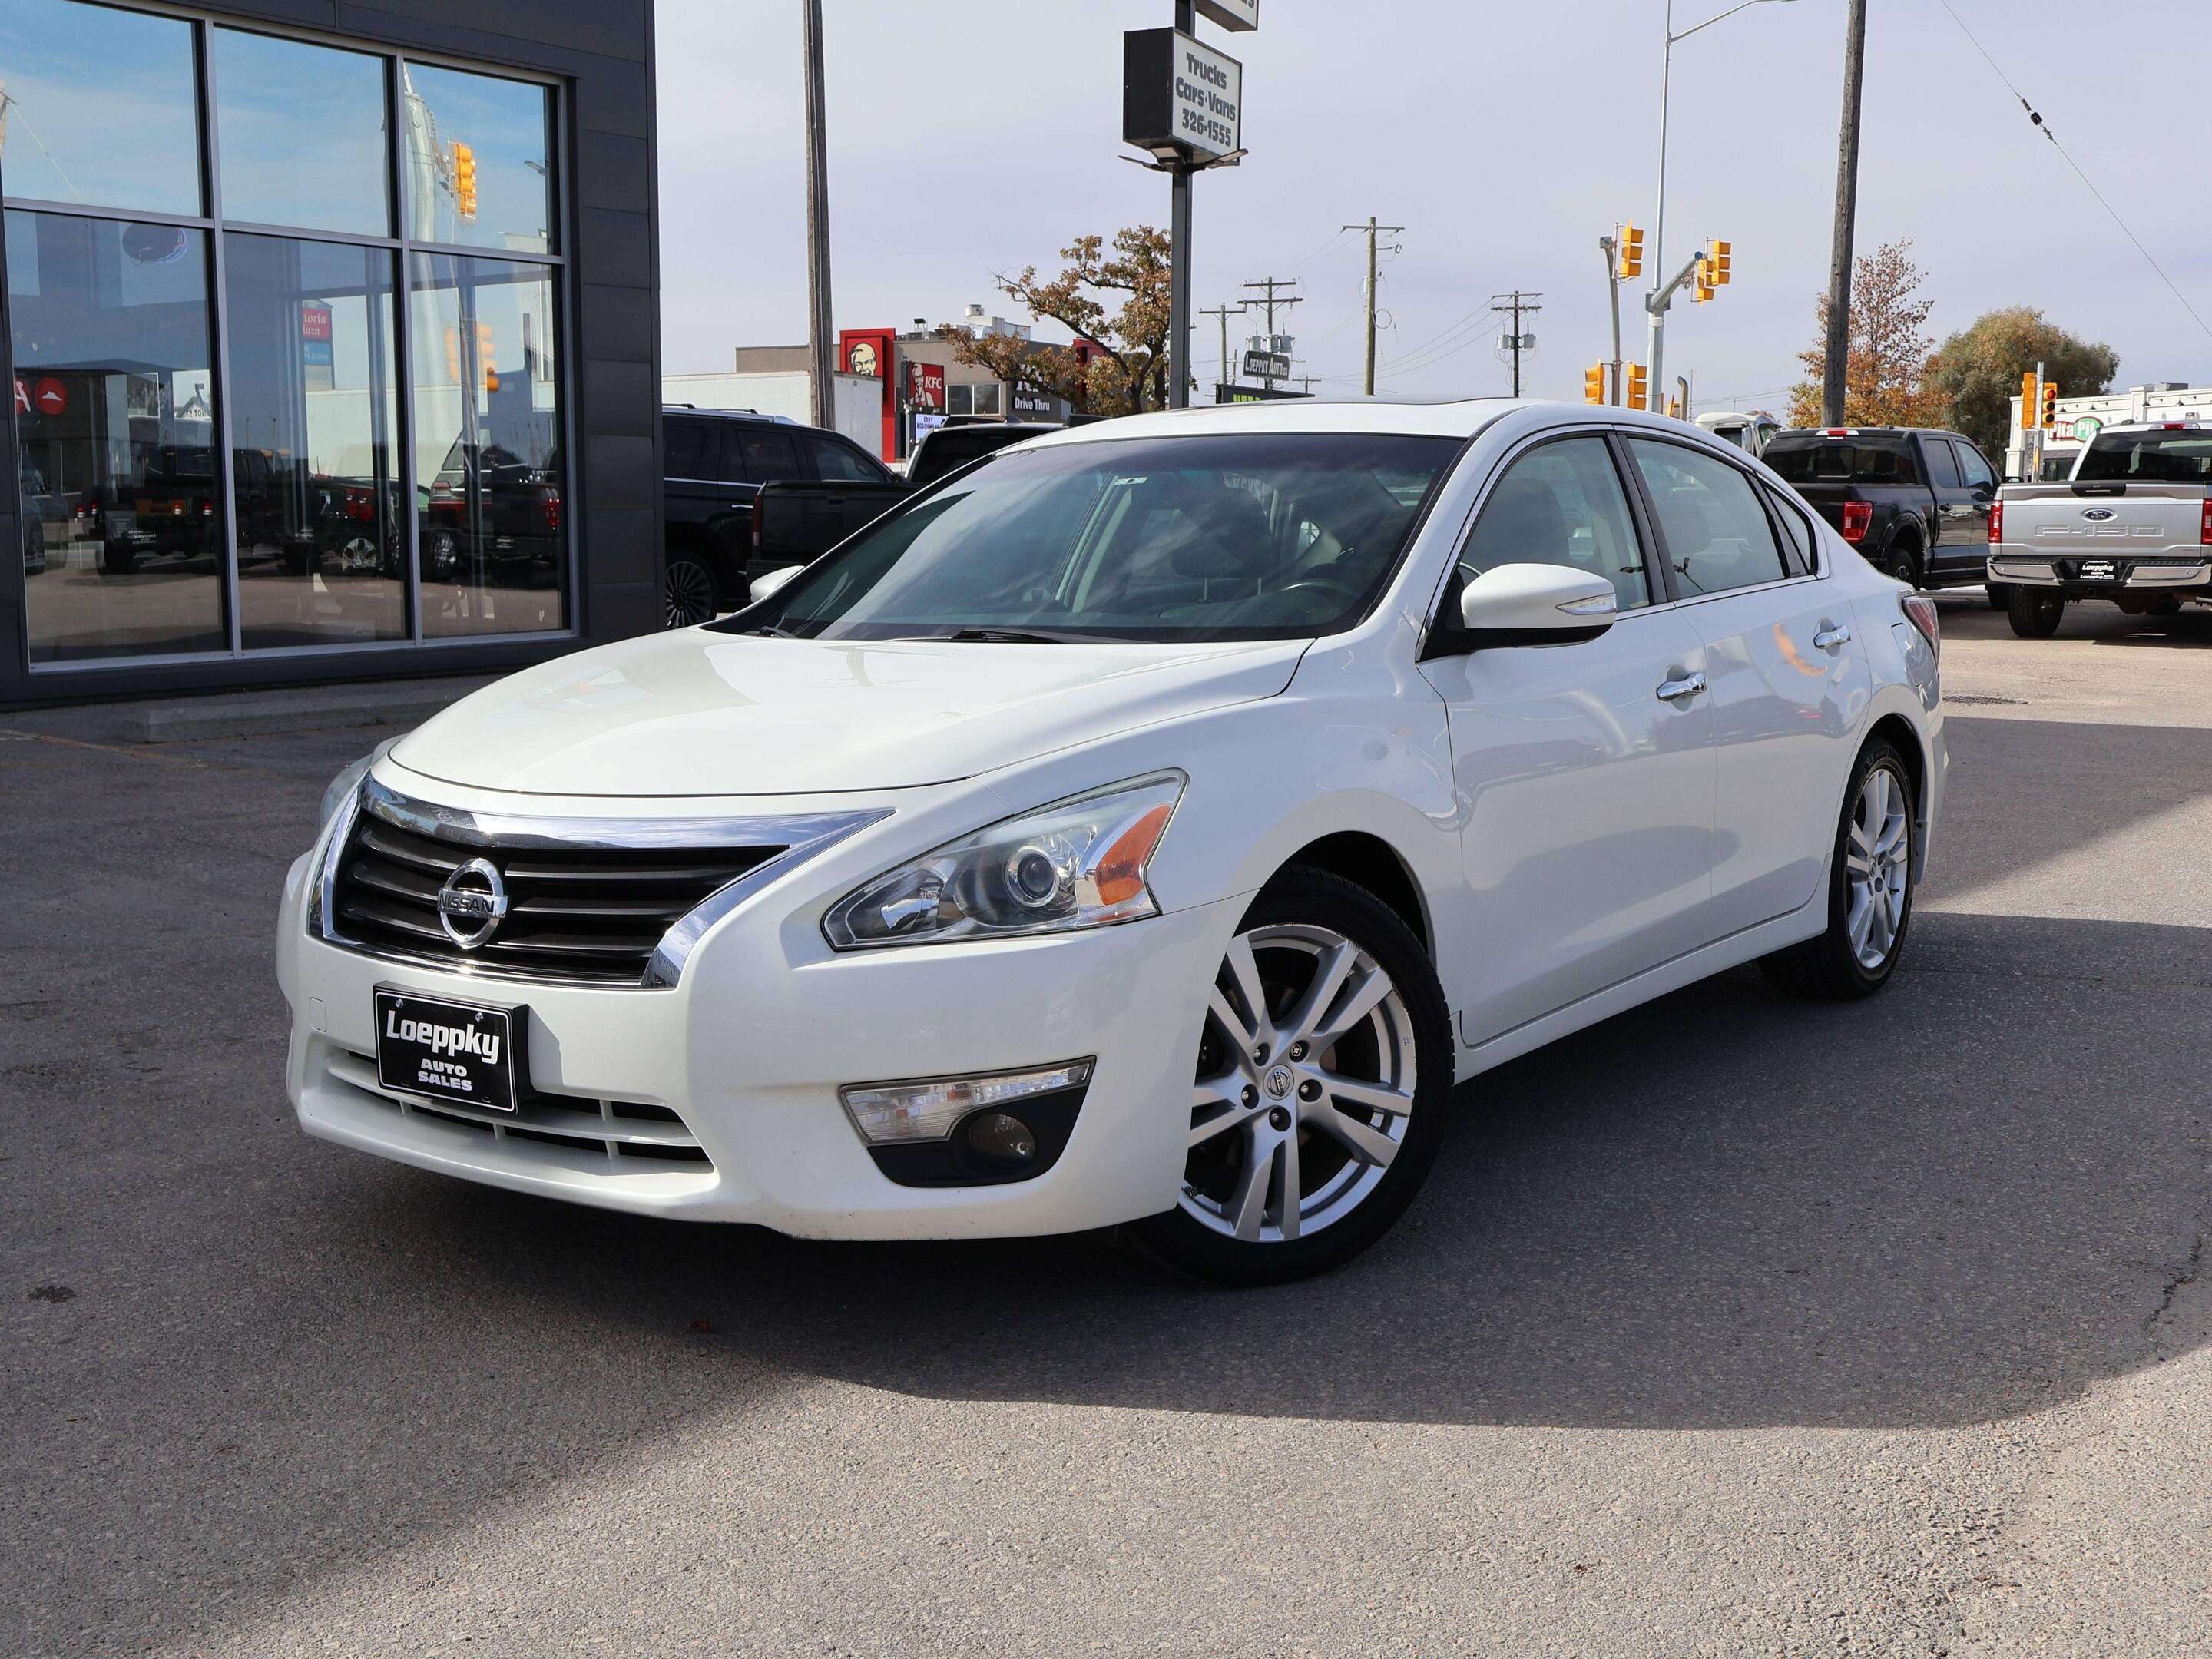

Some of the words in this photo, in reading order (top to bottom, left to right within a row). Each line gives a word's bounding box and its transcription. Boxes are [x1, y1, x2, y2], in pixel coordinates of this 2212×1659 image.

[1186, 51, 1227, 90] Trucks
[924, 376, 942, 389] KFC
[1015, 396, 1033, 410] Drive
[1034, 398, 1050, 412] Thru
[2035, 525, 2164, 537] F-150
[2082, 564, 2114, 572] Loeppky
[439, 892, 495, 914] NISSAN
[386, 1009, 500, 1065] Loeppky
[421, 1058, 468, 1077] AUTO
[418, 1071, 473, 1091] SALES
